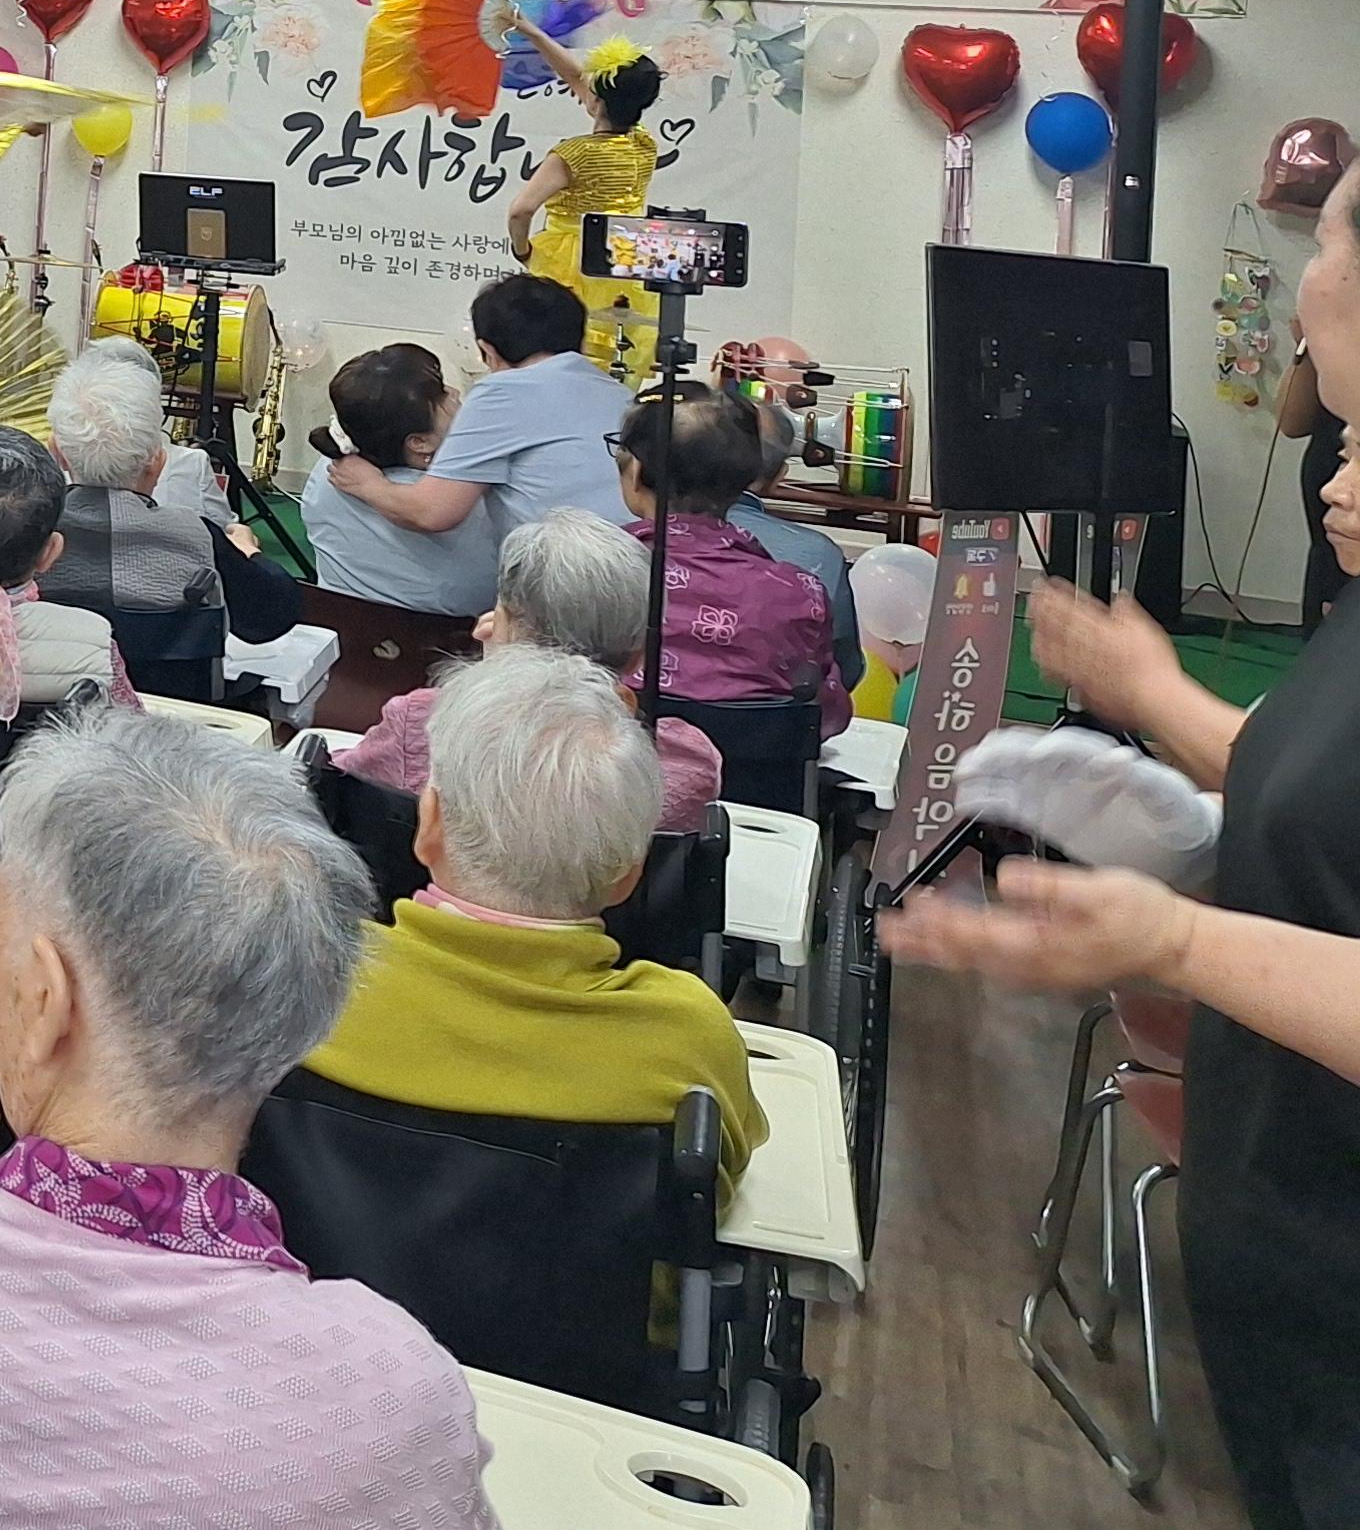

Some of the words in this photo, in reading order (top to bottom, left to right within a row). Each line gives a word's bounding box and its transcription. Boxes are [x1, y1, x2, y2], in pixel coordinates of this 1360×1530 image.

[290, 218, 364, 245] 부모님의
[369, 227, 446, 253] 아낌없는
[452, 233, 511, 257] 사랑에
[338, 252, 378, 274] 마음
[384, 255, 419, 278] 깊이
[424, 258, 500, 282] 존경하며
